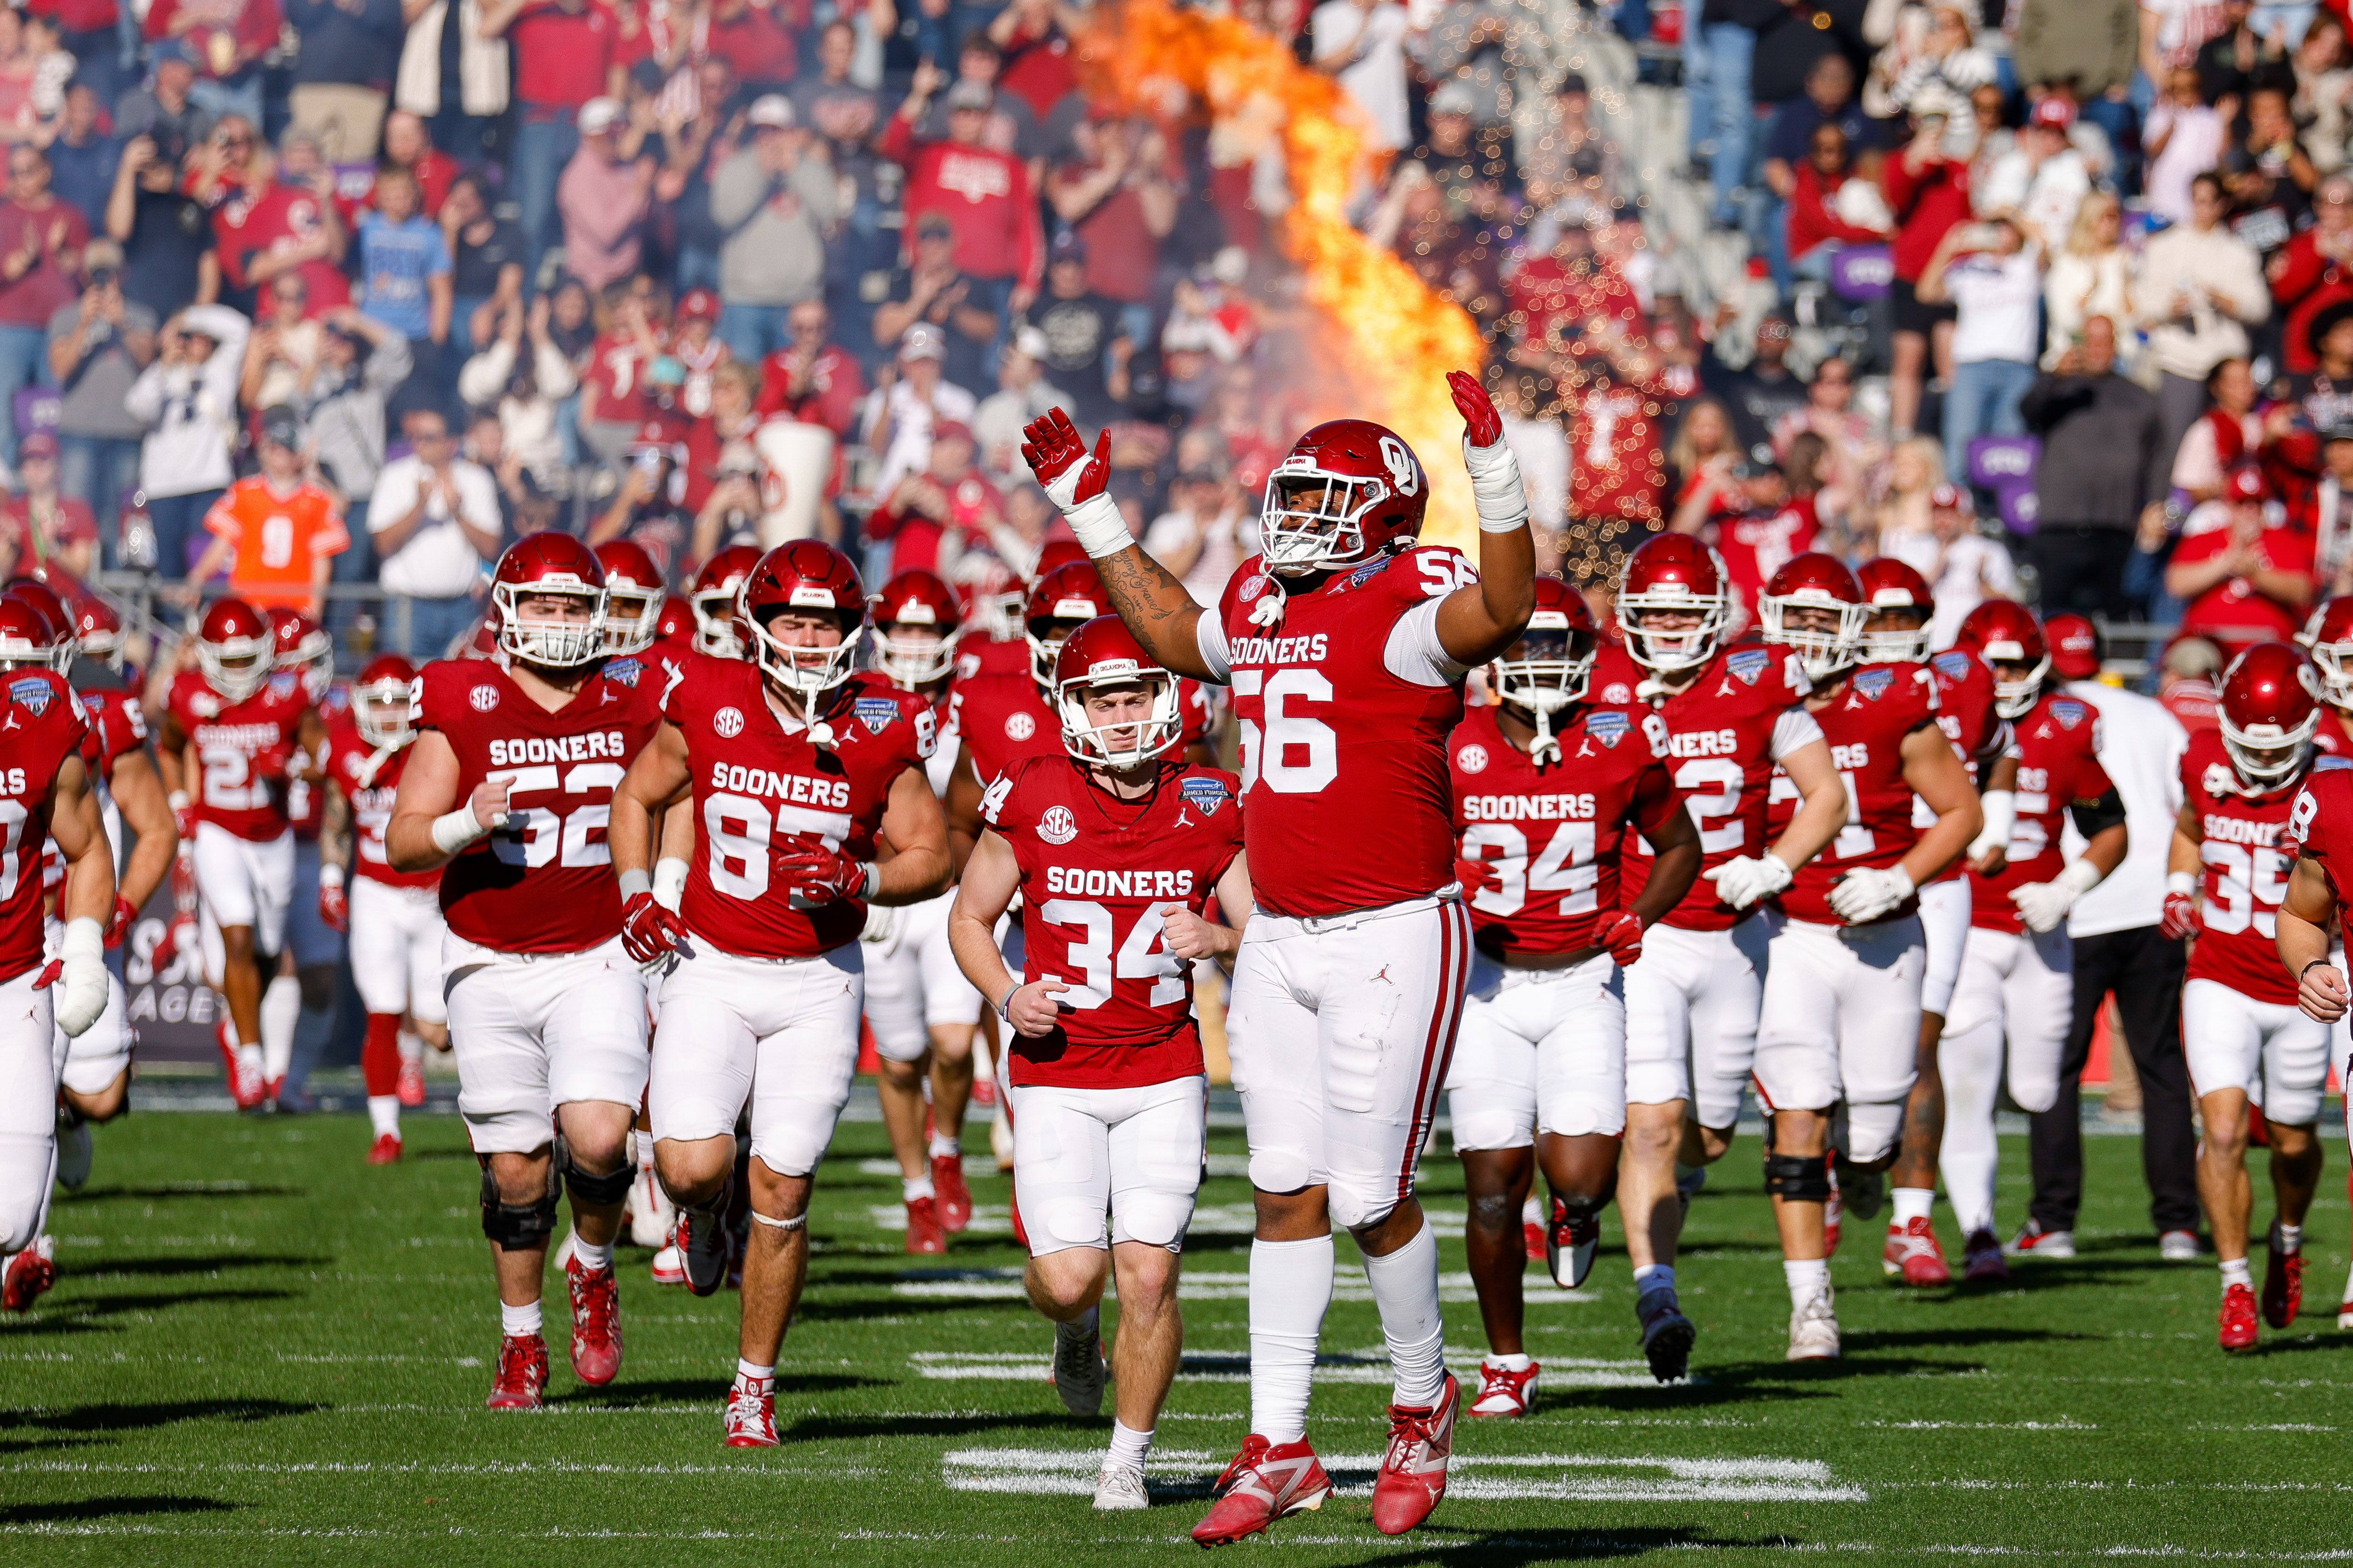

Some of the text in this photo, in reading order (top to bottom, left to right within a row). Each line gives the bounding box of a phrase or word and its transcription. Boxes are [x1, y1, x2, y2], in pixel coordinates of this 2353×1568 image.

[1229, 633, 1329, 665] SOONERS
[1100, 663, 1127, 672] OKLAHOMA
[471, 685, 497, 711] SEC
[717, 708, 742, 736] SEC
[914, 706, 937, 758] 8
[1231, 668, 1338, 794] 56
[489, 731, 625, 766] SOONERS
[1667, 728, 1738, 758] NERS
[711, 761, 851, 808] SOONERS
[1044, 807, 1073, 835] SEC
[1463, 793, 1596, 820] SOONERS
[703, 791, 853, 910] 87
[1040, 831, 1073, 844] GRADUATE
[1046, 866, 1194, 897] SOONERS
[1040, 898, 1189, 1010] 34
[748, 1381, 759, 1396] OU
